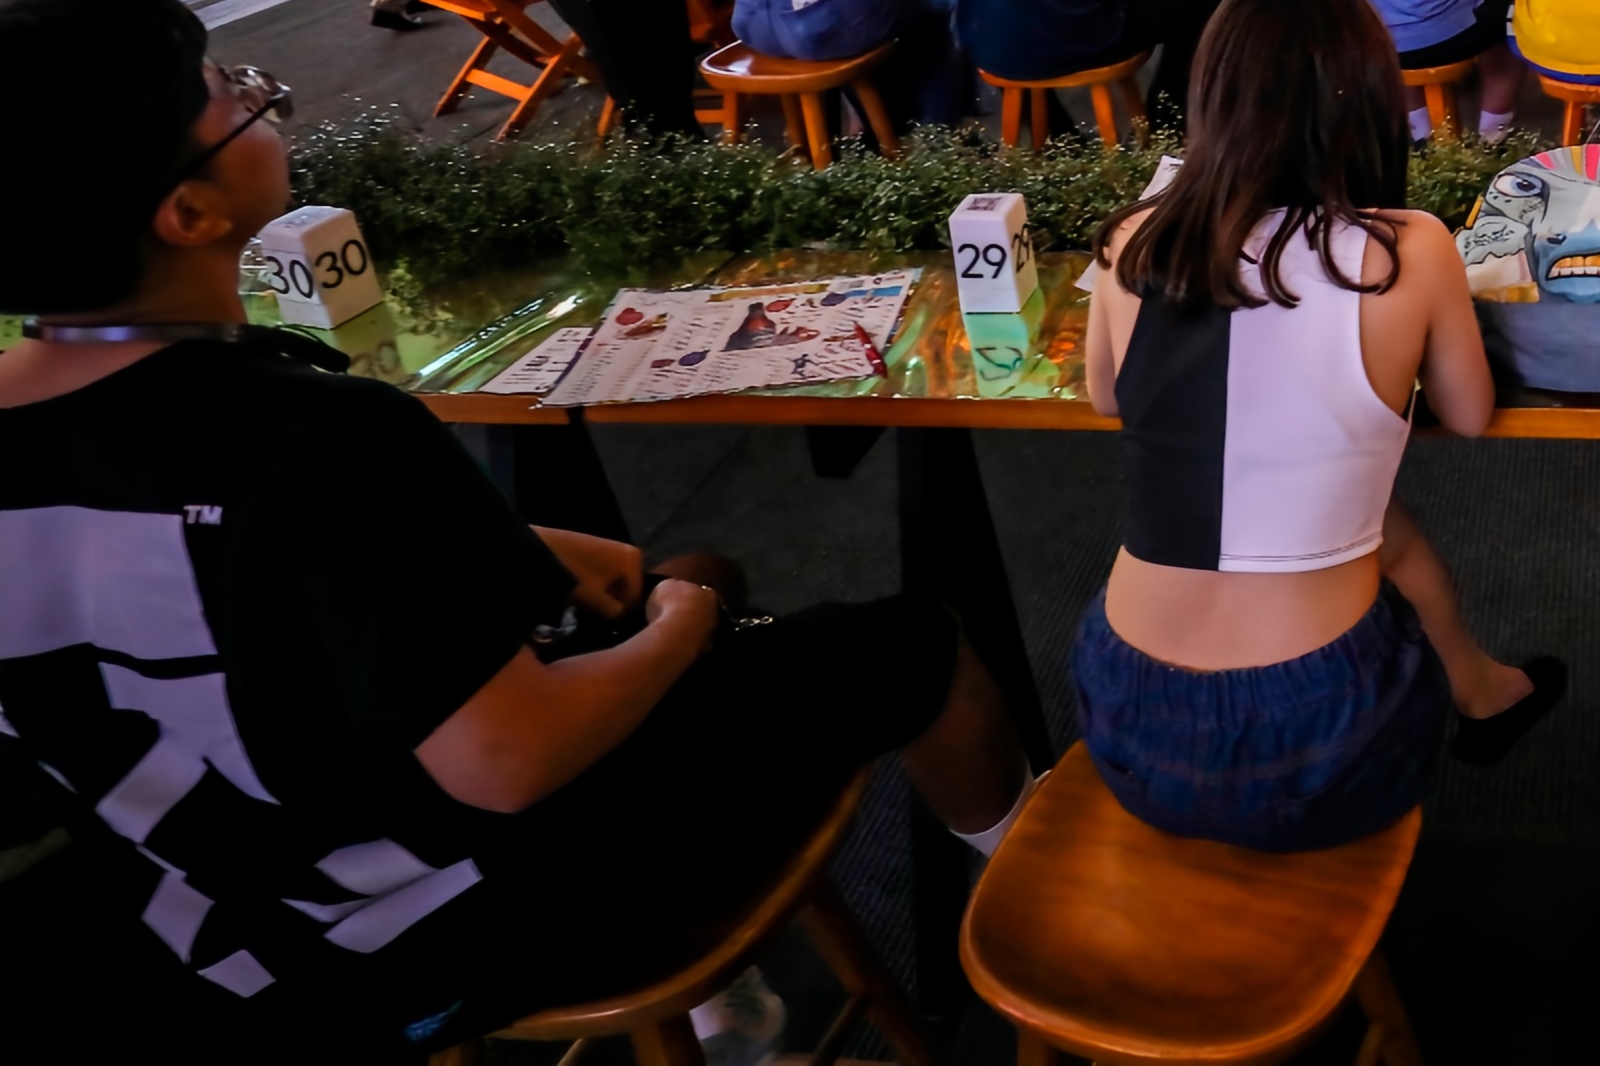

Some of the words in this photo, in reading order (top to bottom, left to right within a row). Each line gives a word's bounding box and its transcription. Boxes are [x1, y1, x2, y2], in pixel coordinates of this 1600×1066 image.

[265, 255, 314, 299] 30
[314, 239, 368, 289] 30
[957, 243, 1008, 279] 29
[183, 504, 223, 525] TM
